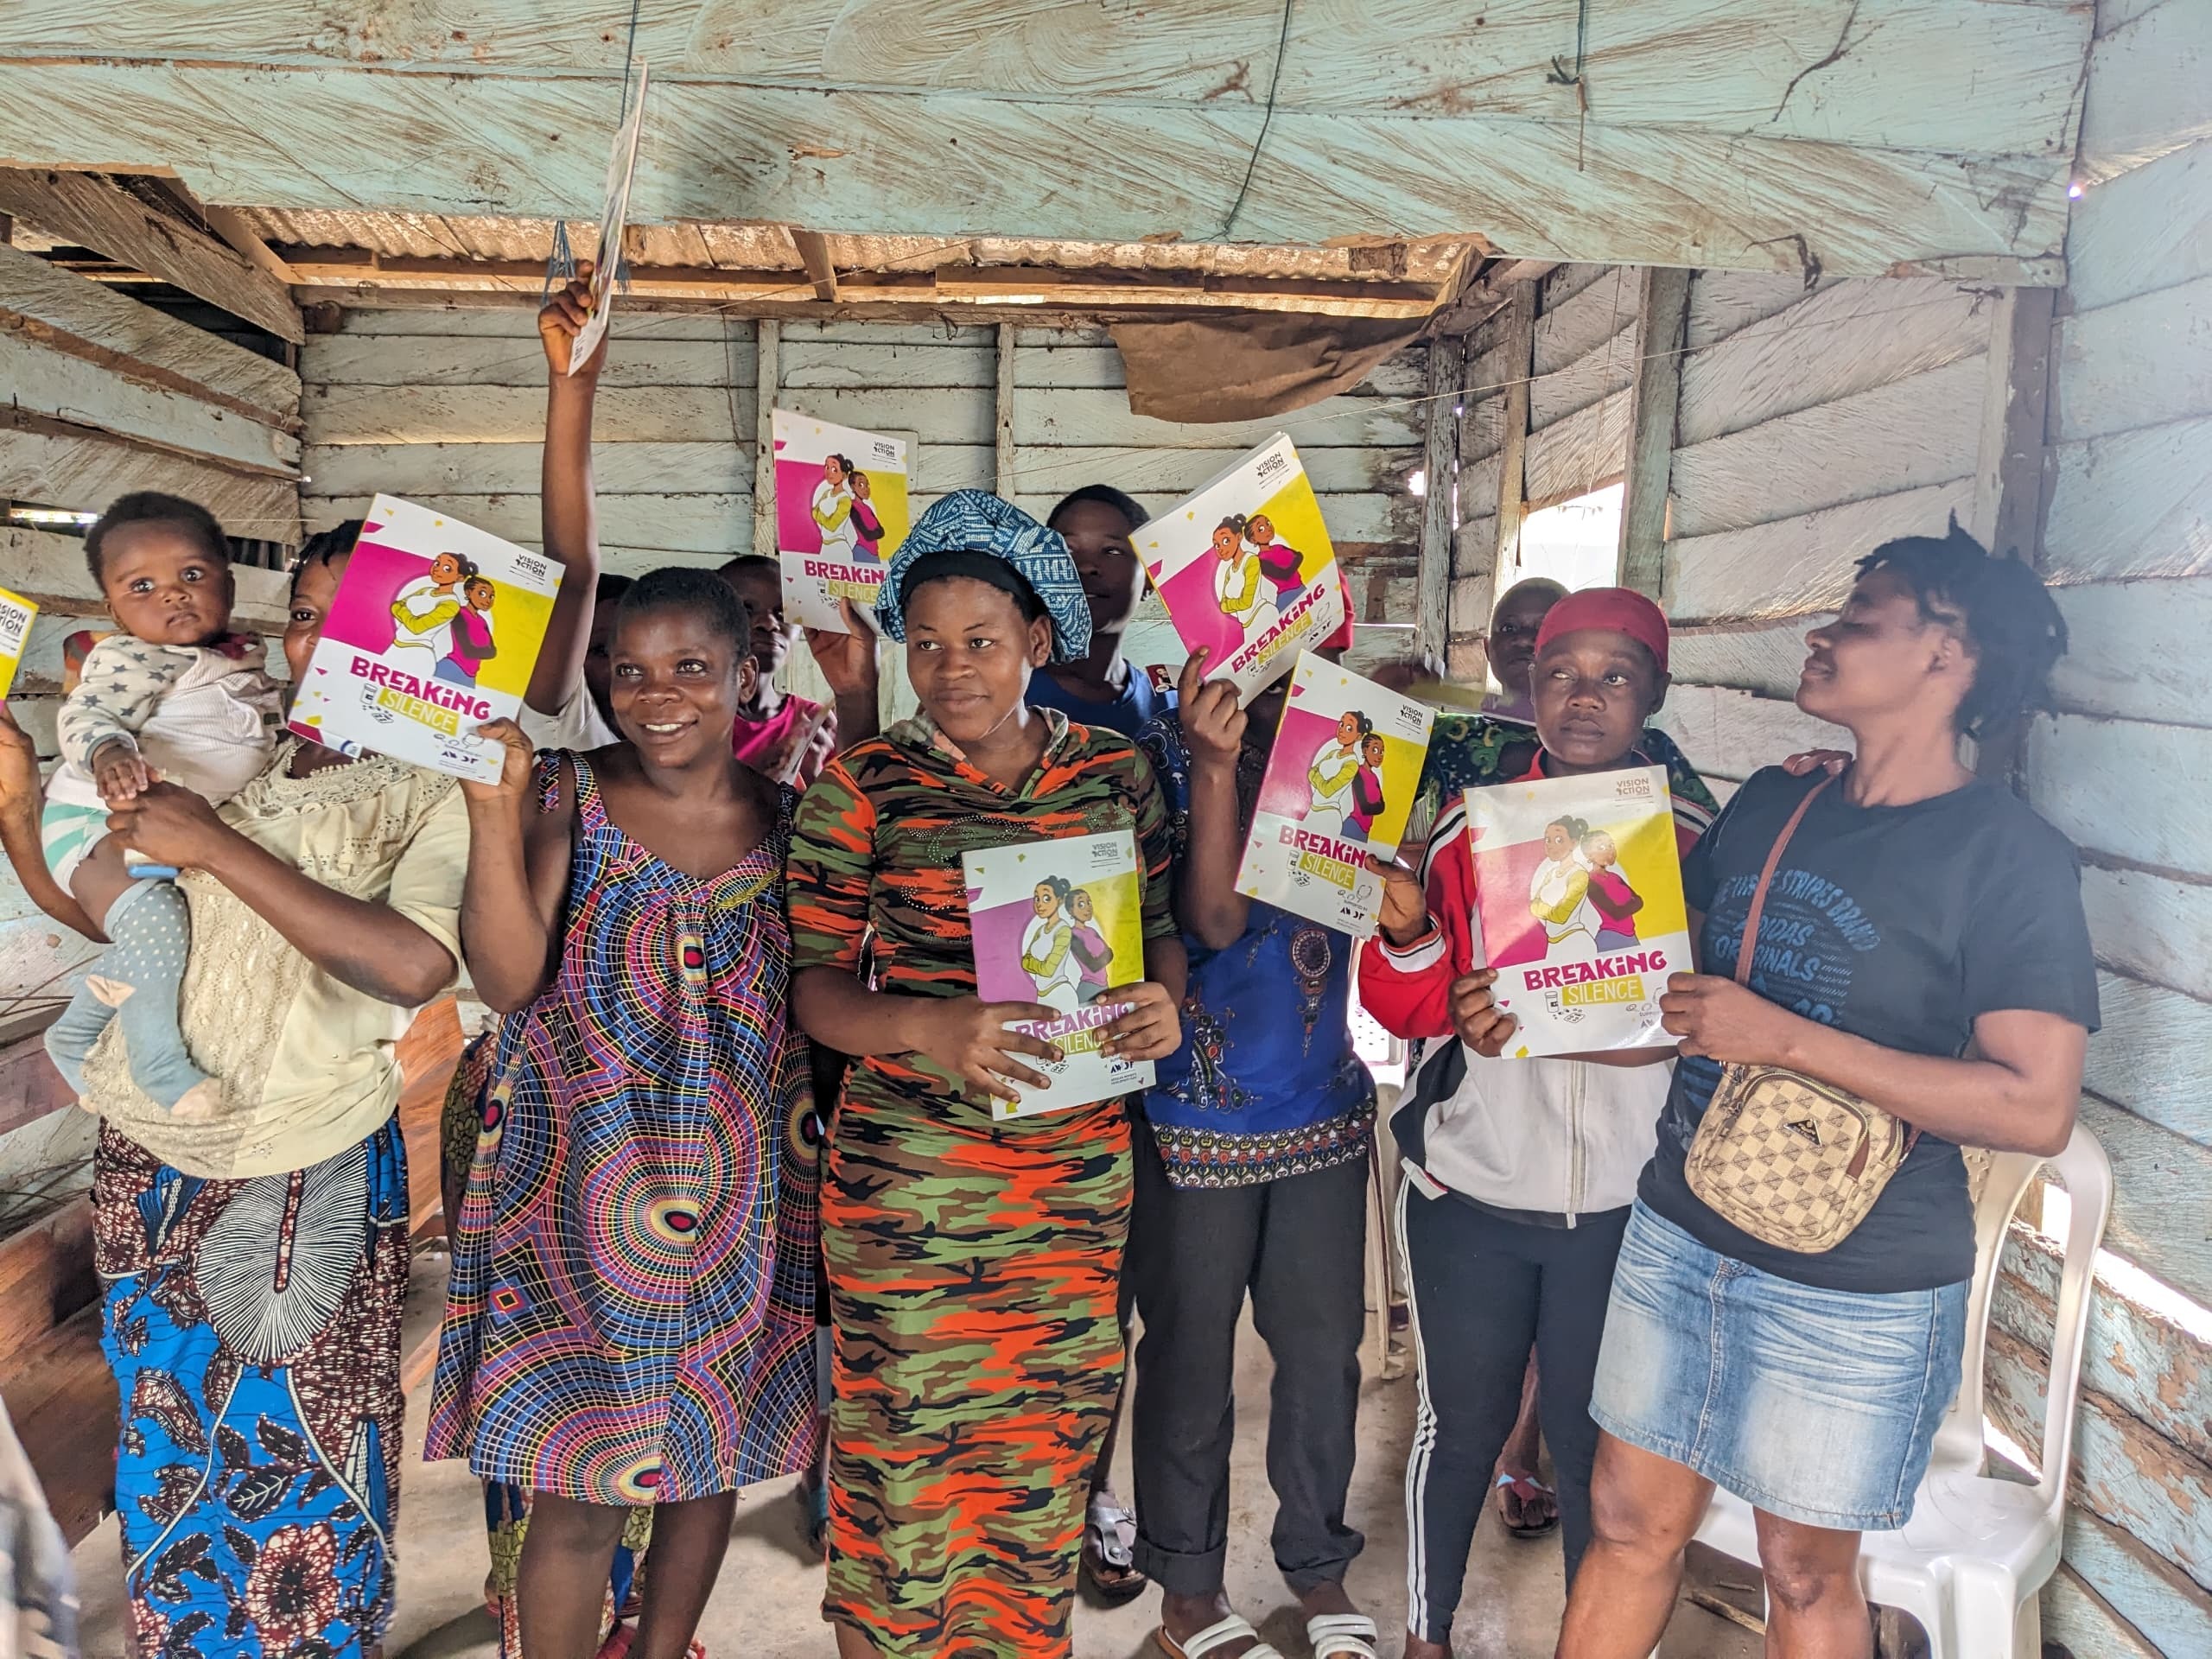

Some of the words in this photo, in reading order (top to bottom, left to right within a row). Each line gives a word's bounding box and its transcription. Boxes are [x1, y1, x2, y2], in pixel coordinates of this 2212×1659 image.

[874, 441, 895, 451] VISION
[1256, 451, 1281, 472] VISION
[518, 554, 547, 570] VISION
[804, 560, 886, 585] BREAKIN
[1262, 616, 1309, 660] SILENCE
[384, 690, 456, 732] SILENCE
[1402, 704, 1424, 718] VISION
[1617, 778, 1649, 787] VISION
[1279, 824, 1370, 871] BREAKIN
[1304, 854, 1355, 887] SILENCE
[1715, 935, 1821, 982] ORGINALS
[1568, 979, 1639, 1004] SILENCE
[1054, 1028, 1103, 1055] SILENC
